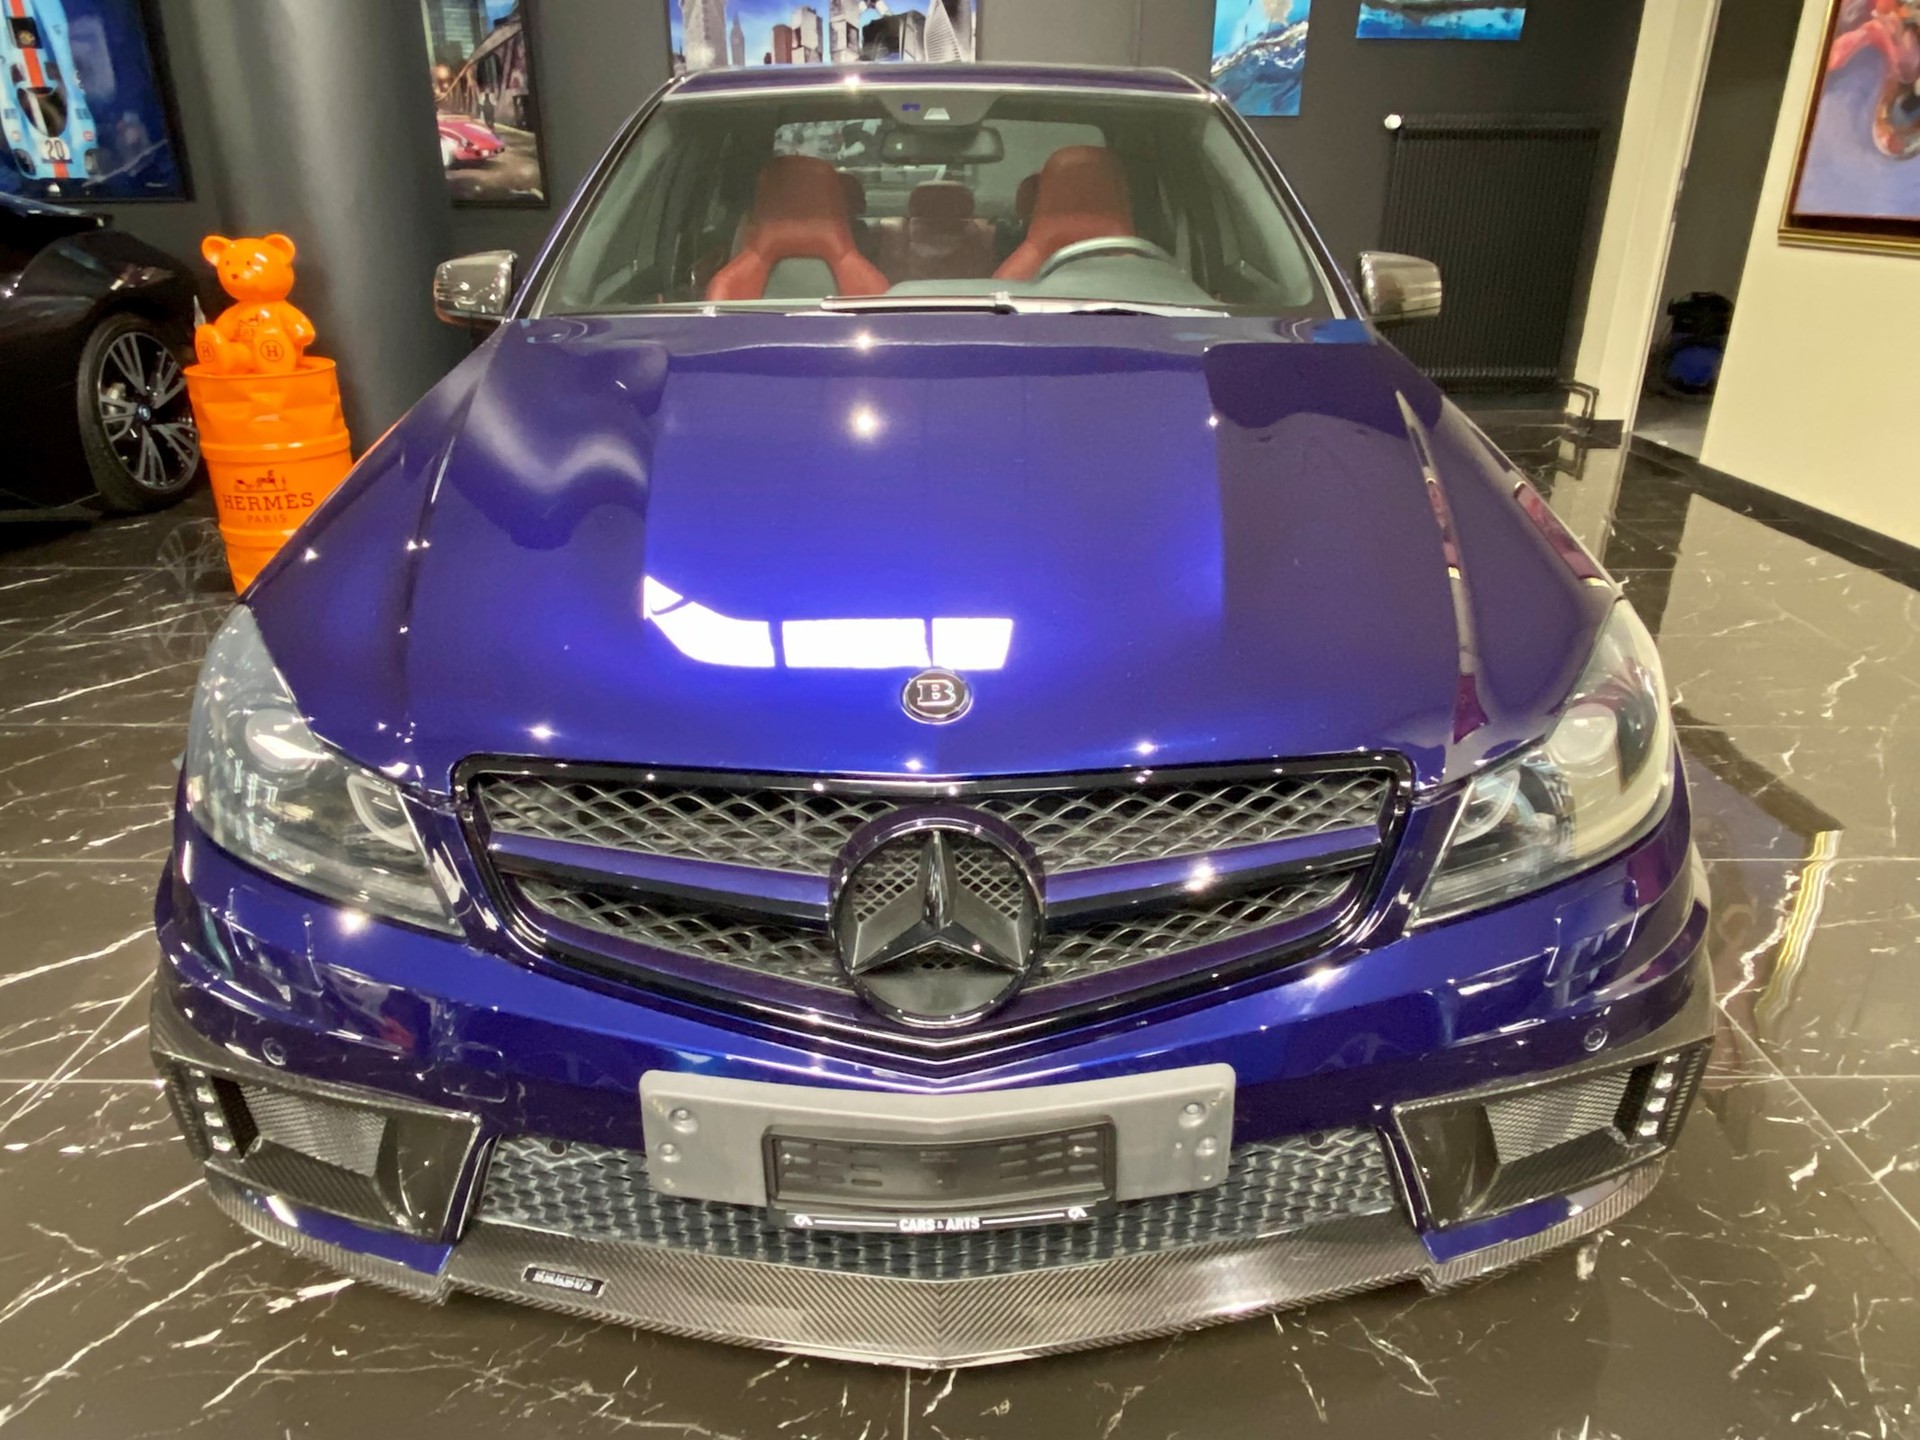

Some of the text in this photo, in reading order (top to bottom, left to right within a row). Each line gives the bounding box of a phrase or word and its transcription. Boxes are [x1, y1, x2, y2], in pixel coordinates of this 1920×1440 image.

[45, 139, 66, 161] 20
[246, 514, 287, 524] PARIS
[916, 679, 957, 706] B
[900, 1218, 936, 1232] CARS
[946, 1216, 980, 1231] ARTS
